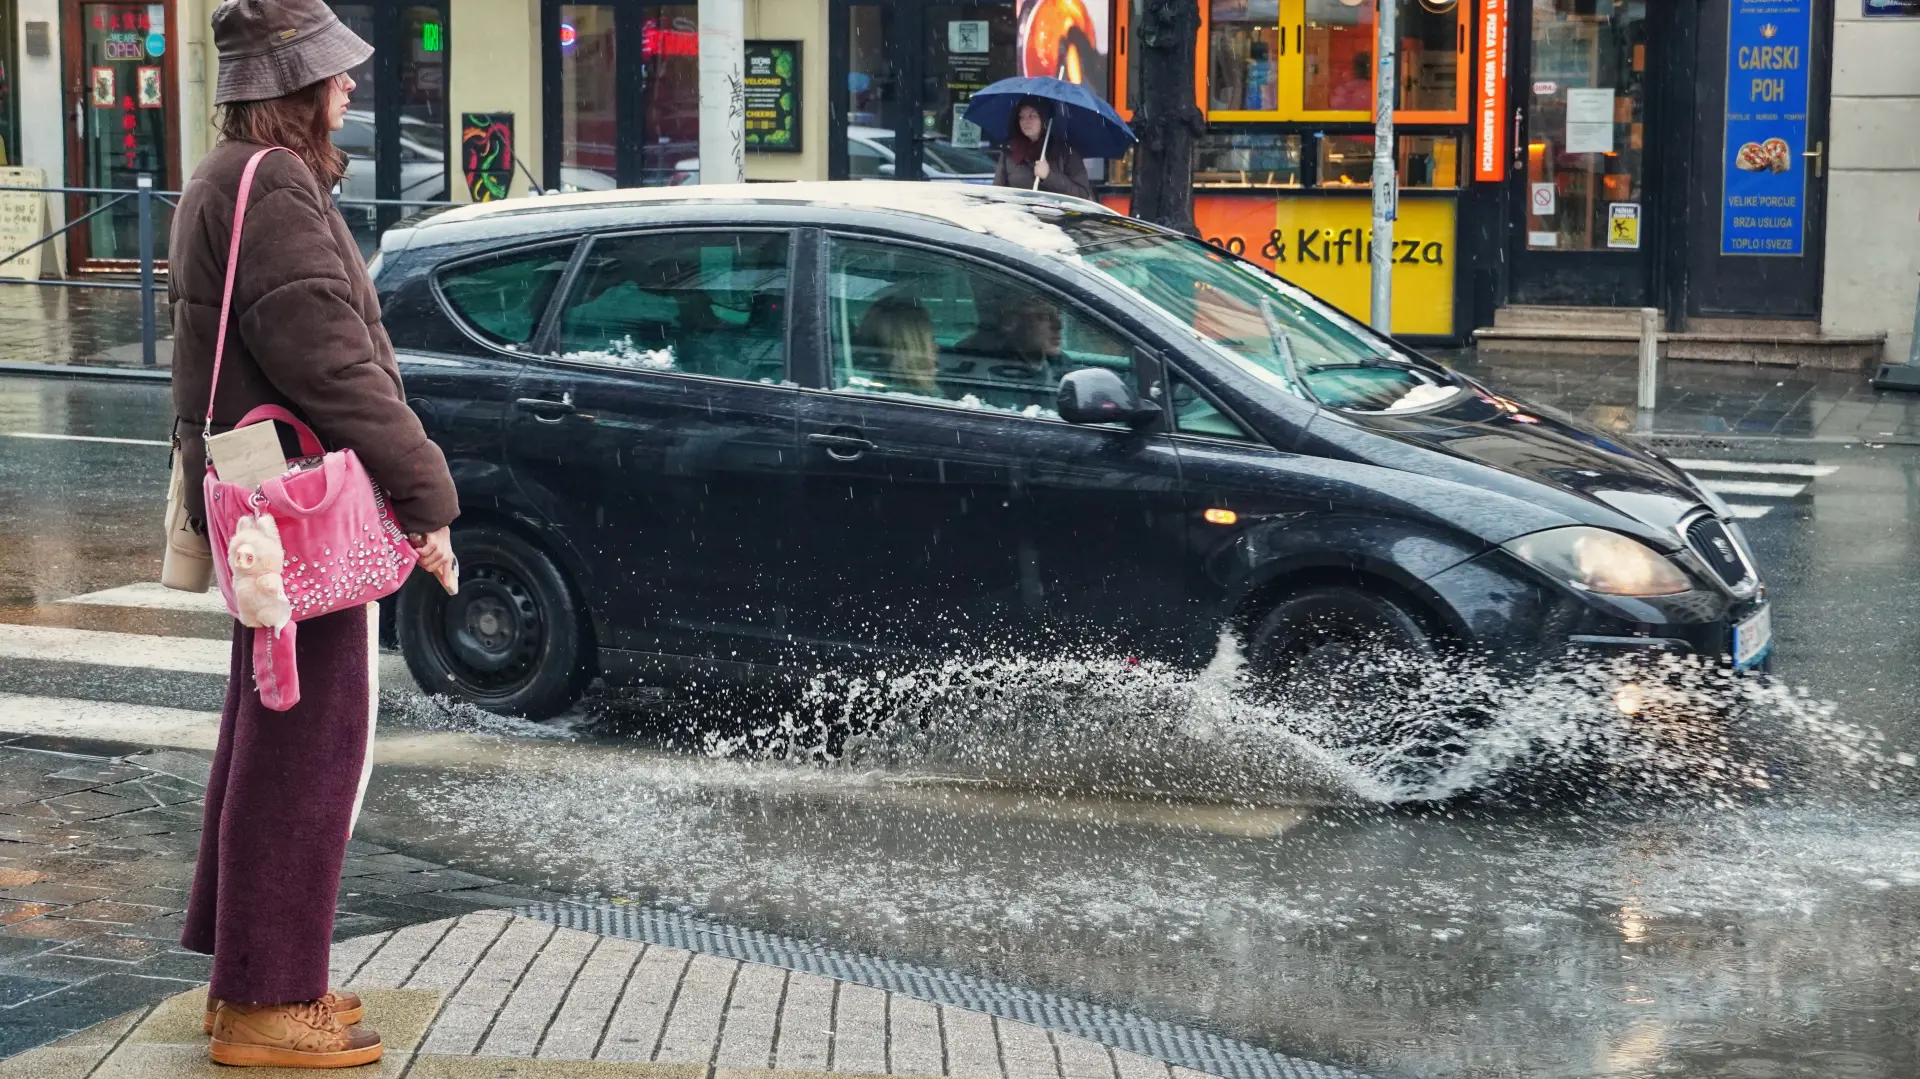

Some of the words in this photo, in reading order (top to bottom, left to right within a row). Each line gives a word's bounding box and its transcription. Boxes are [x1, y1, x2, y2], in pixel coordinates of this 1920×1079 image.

[1486, 13, 1497, 48] PIZZA
[107, 43, 142, 58] OPEN
[1738, 46, 1799, 70] CARSKI
[1484, 60, 1497, 97] WRAP
[1751, 78, 1784, 102] POH
[1482, 109, 1495, 172] SANDWICH
[1728, 195, 1758, 207] VELIKE
[1759, 196, 1796, 208] PORCIJE
[1733, 216, 1757, 228] BRZA
[1757, 216, 1792, 228] USLUGA
[1262, 229, 1286, 262] &
[1731, 237, 1759, 249] TOPLO
